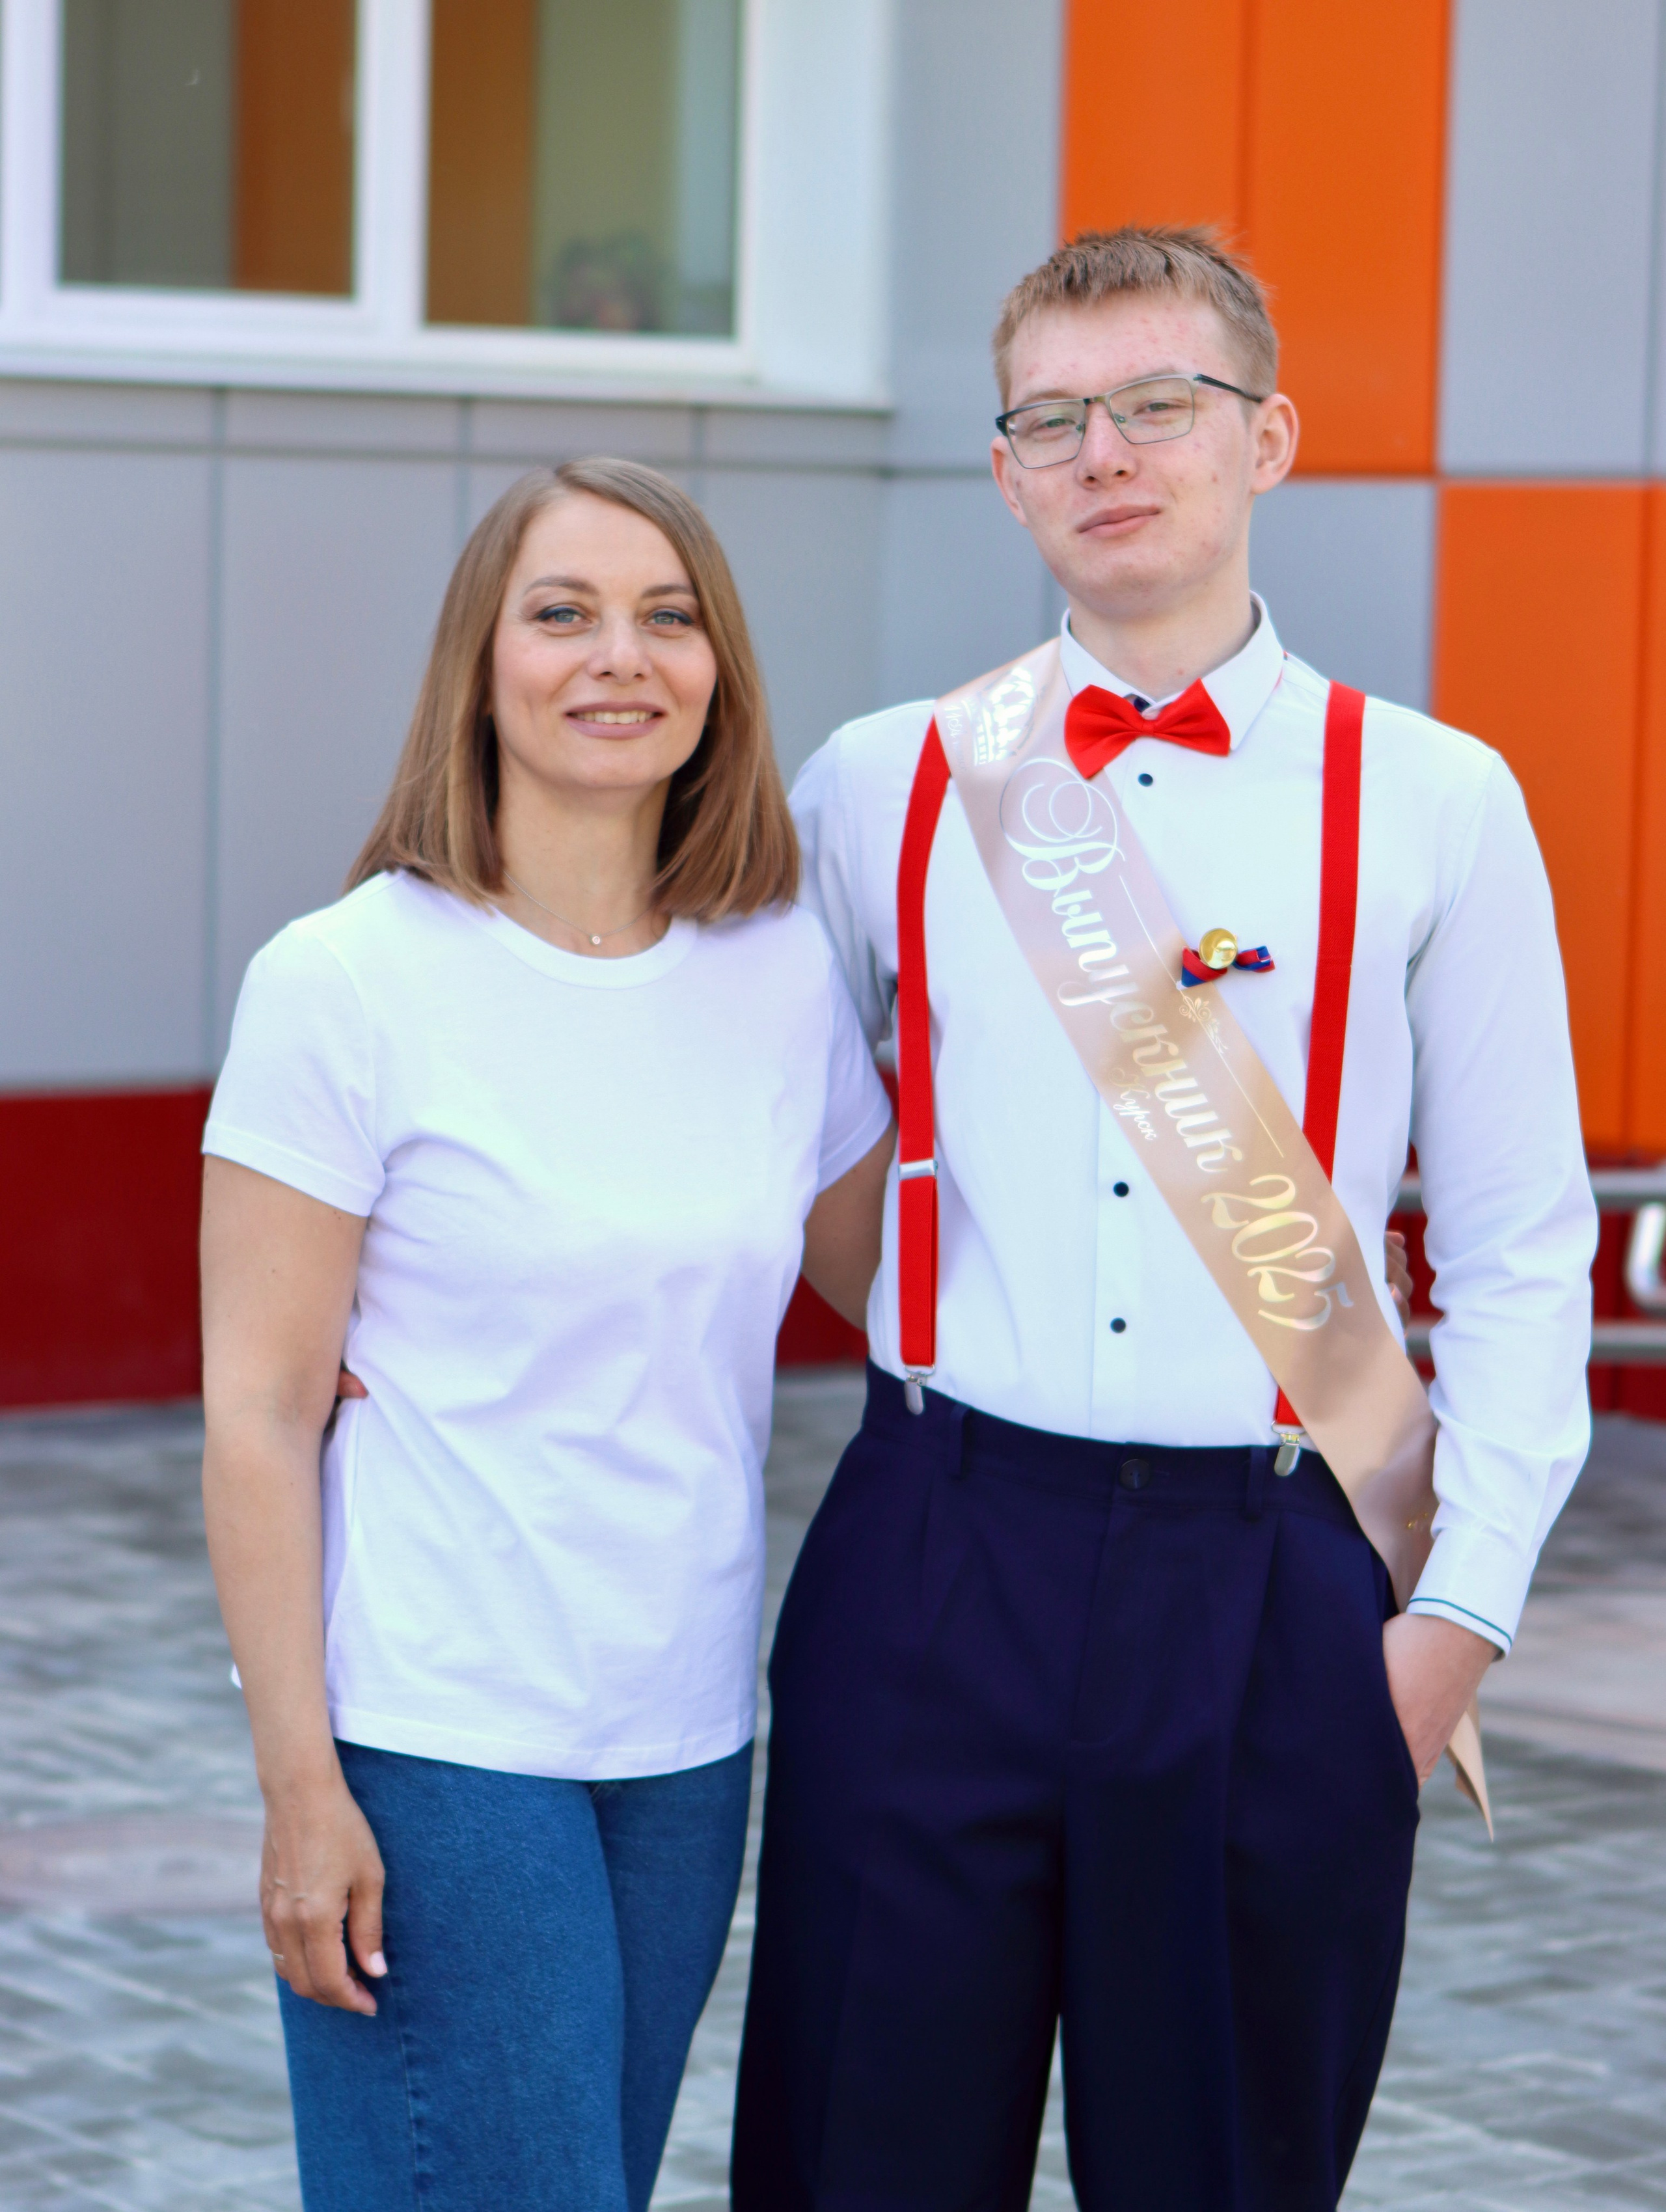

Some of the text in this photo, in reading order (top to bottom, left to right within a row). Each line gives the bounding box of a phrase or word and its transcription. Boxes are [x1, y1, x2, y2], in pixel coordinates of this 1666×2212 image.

[999, 758, 1354, 1331] Выпускник 2025
[1108, 1067, 1156, 1140] Курск
